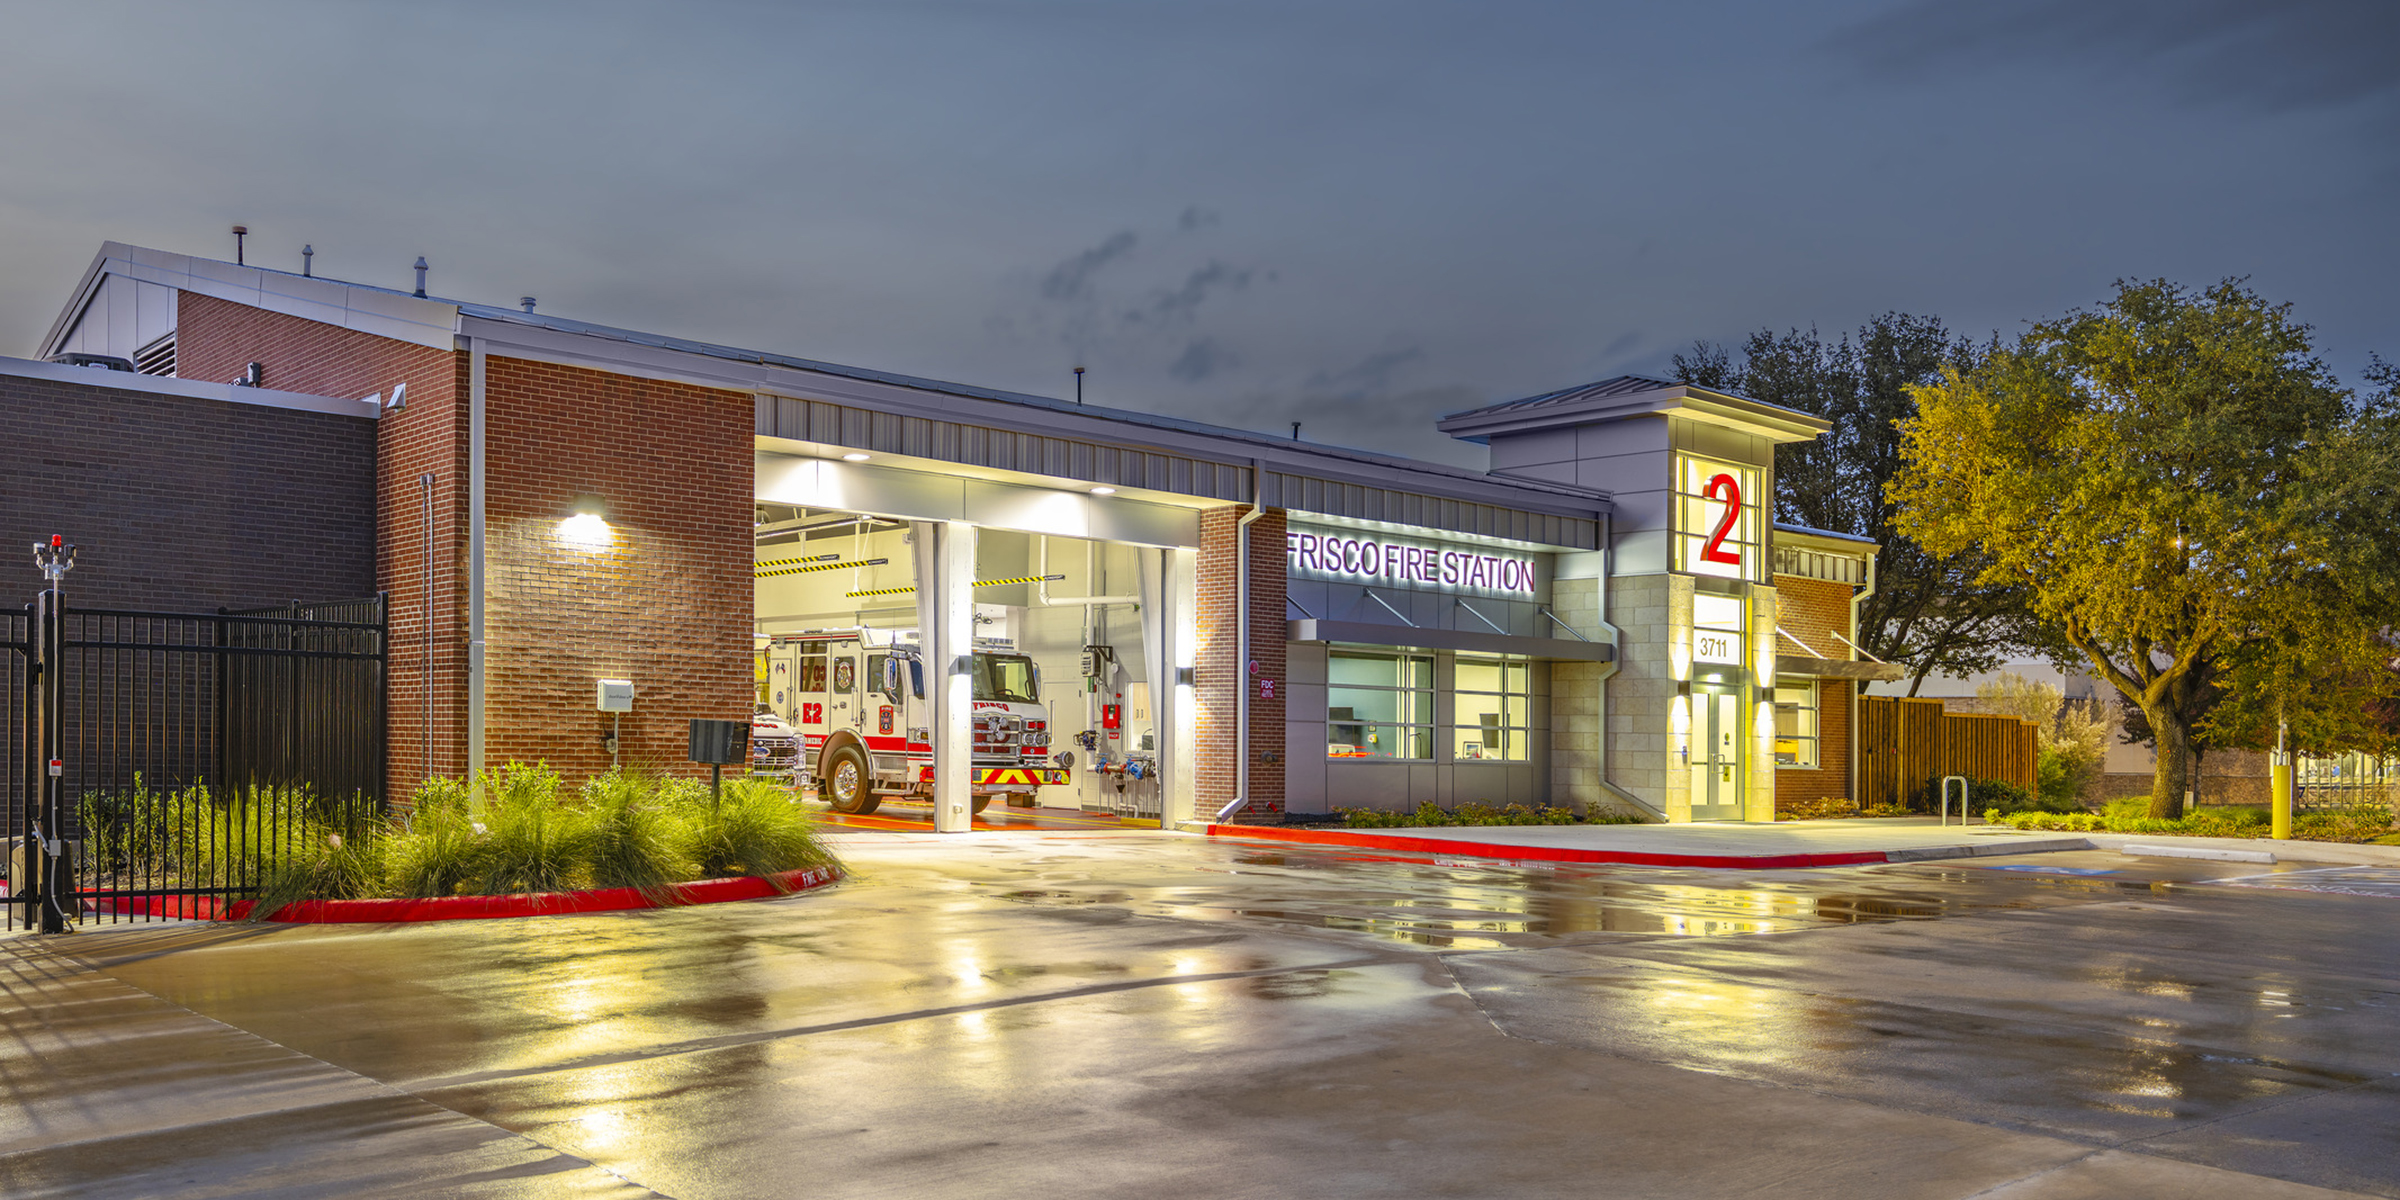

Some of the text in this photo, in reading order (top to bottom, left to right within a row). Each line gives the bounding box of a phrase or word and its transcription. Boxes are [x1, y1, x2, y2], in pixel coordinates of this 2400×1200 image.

[1700, 473, 1740, 565] 2
[1385, 546, 1438, 582] FIRE
[1443, 552, 1535, 592] STATION
[1700, 637, 1727, 658] 3711
[1261, 680, 1274, 689] FDC
[802, 702, 822, 724] E2
